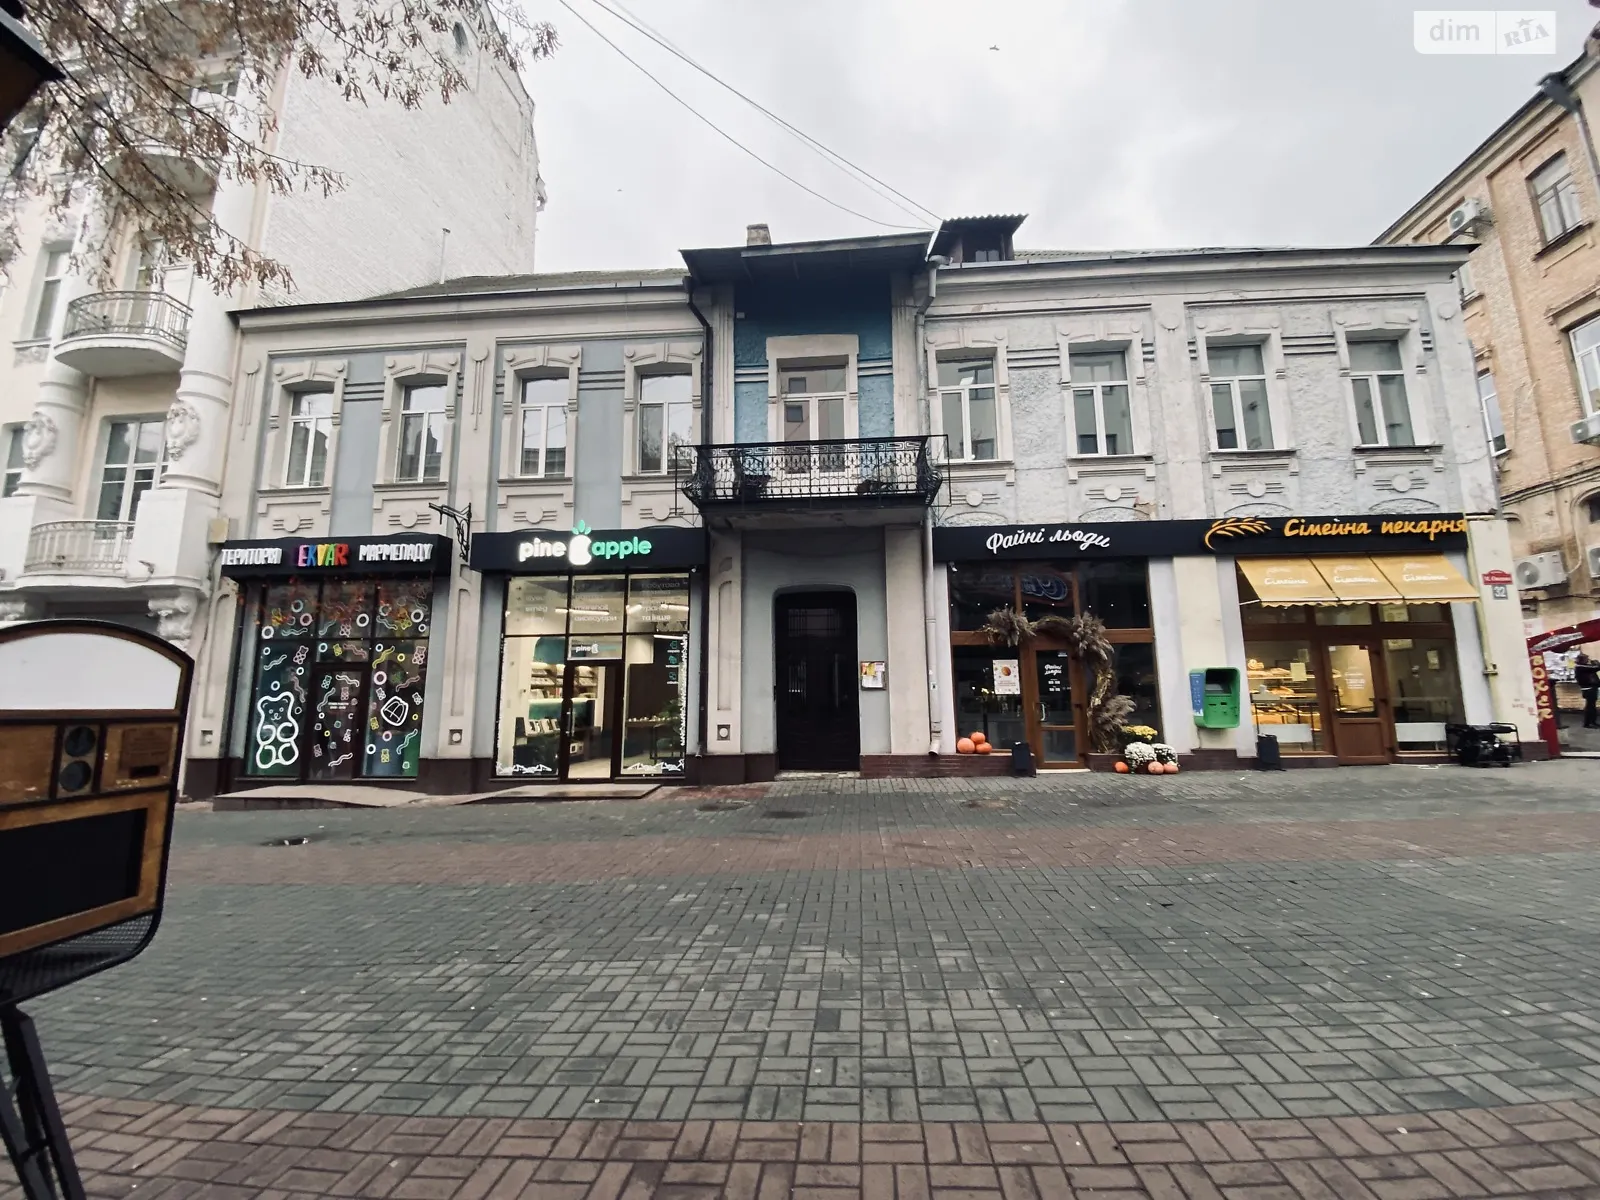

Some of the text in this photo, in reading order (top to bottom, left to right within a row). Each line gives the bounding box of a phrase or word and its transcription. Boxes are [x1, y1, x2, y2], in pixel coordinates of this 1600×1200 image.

[986, 528, 1111, 554] Файні льоди
[1284, 517, 1466, 541] Сімейна пекарня
[359, 543, 434, 562] МАРМЕЛАДУ
[518, 536, 652, 562] pine apple
[1494, 586, 1507, 597] 32
